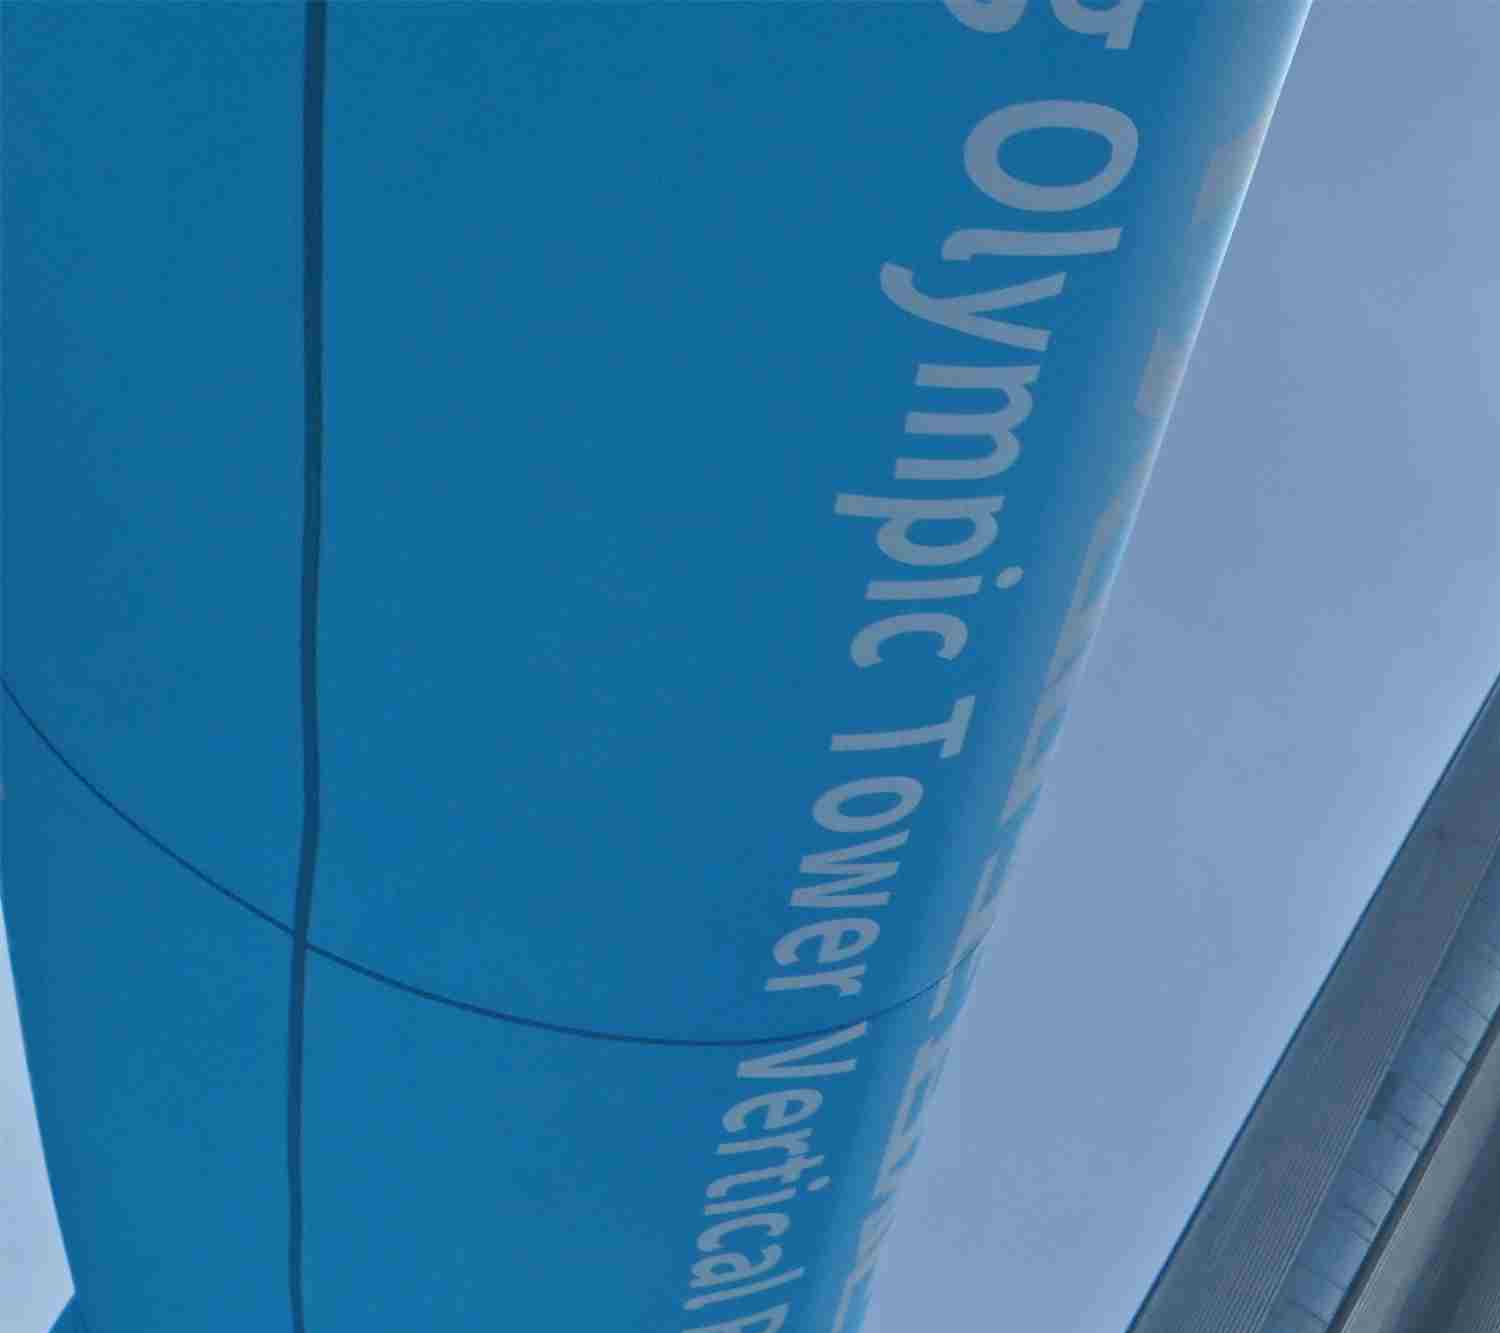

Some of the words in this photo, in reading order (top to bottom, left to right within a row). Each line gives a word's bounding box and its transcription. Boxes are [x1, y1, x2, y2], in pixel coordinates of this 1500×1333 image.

[834, 100, 1139, 668] Olympic
[764, 695, 977, 998] Tower
[683, 1020, 867, 1311] Vertical
